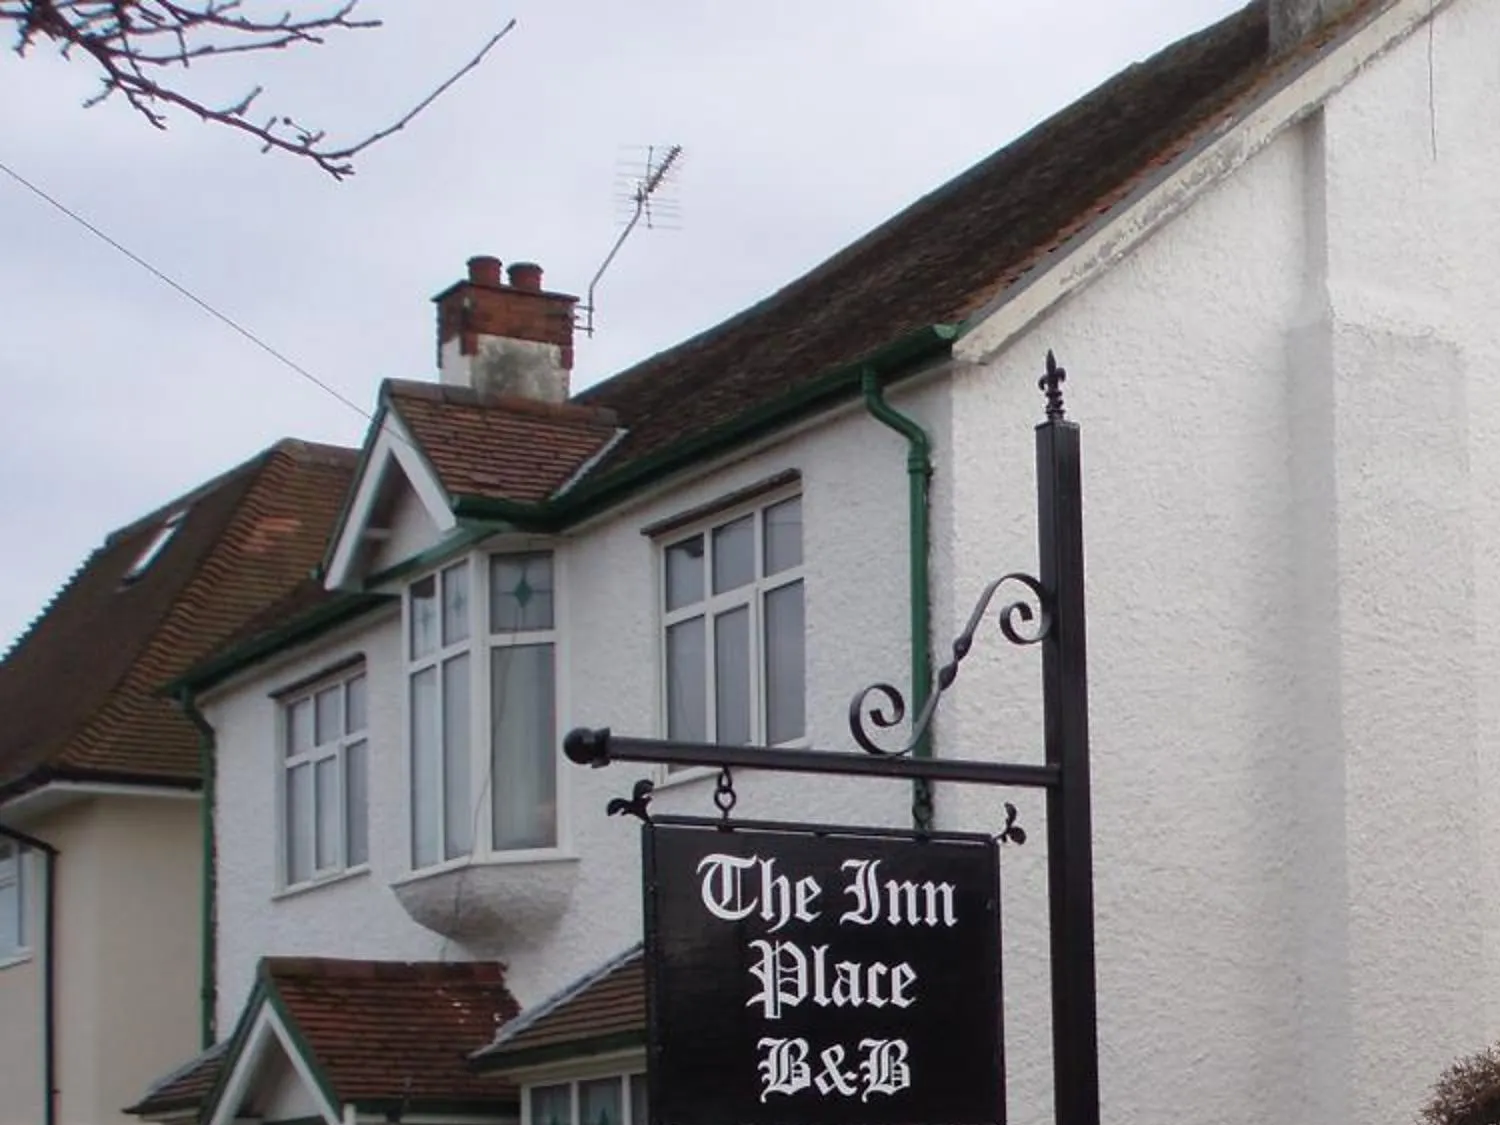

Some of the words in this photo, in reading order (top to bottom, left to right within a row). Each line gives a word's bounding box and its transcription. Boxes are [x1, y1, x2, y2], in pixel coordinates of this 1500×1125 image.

[697, 853, 822, 932] The
[840, 859, 958, 926] Inn
[745, 939, 918, 1019] Place
[757, 1037, 911, 1103] B&B
